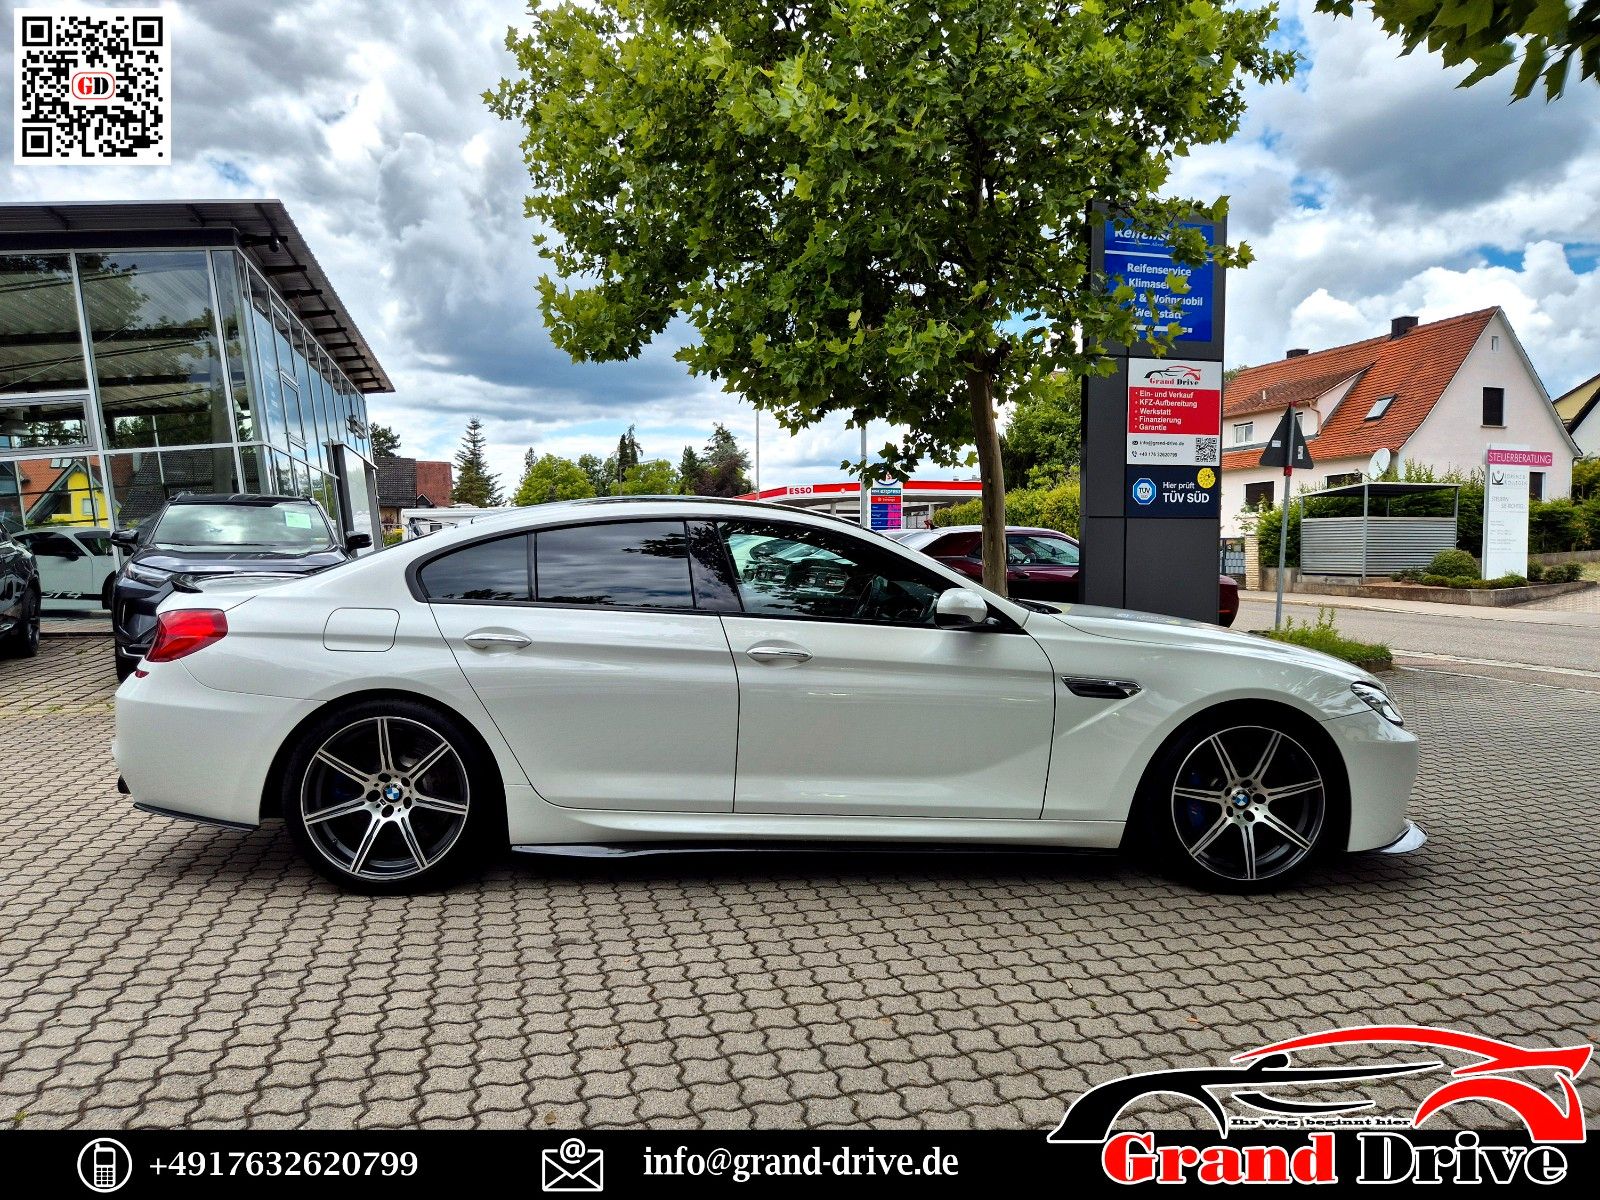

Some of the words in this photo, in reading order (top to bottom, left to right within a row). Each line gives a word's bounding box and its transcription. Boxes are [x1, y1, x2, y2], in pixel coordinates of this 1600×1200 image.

[1127, 263, 1191, 276] Reifenservice
[1176, 378, 1199, 386] Drive
[1168, 391, 1194, 399] Verkauf
[1139, 399, 1198, 408] KFZ-Aufbereitung
[1139, 408, 1171, 416] Werkstatt
[1139, 416, 1182, 424] Finanzierung
[1488, 452, 1552, 464] STEUERBERATUNG
[1162, 481, 1177, 489] Hier
[1178, 482, 1195, 490] prüft
[789, 487, 812, 495] ESSO
[1162, 491, 1186, 503] TÜV
[1186, 491, 1210, 503] SÜD
